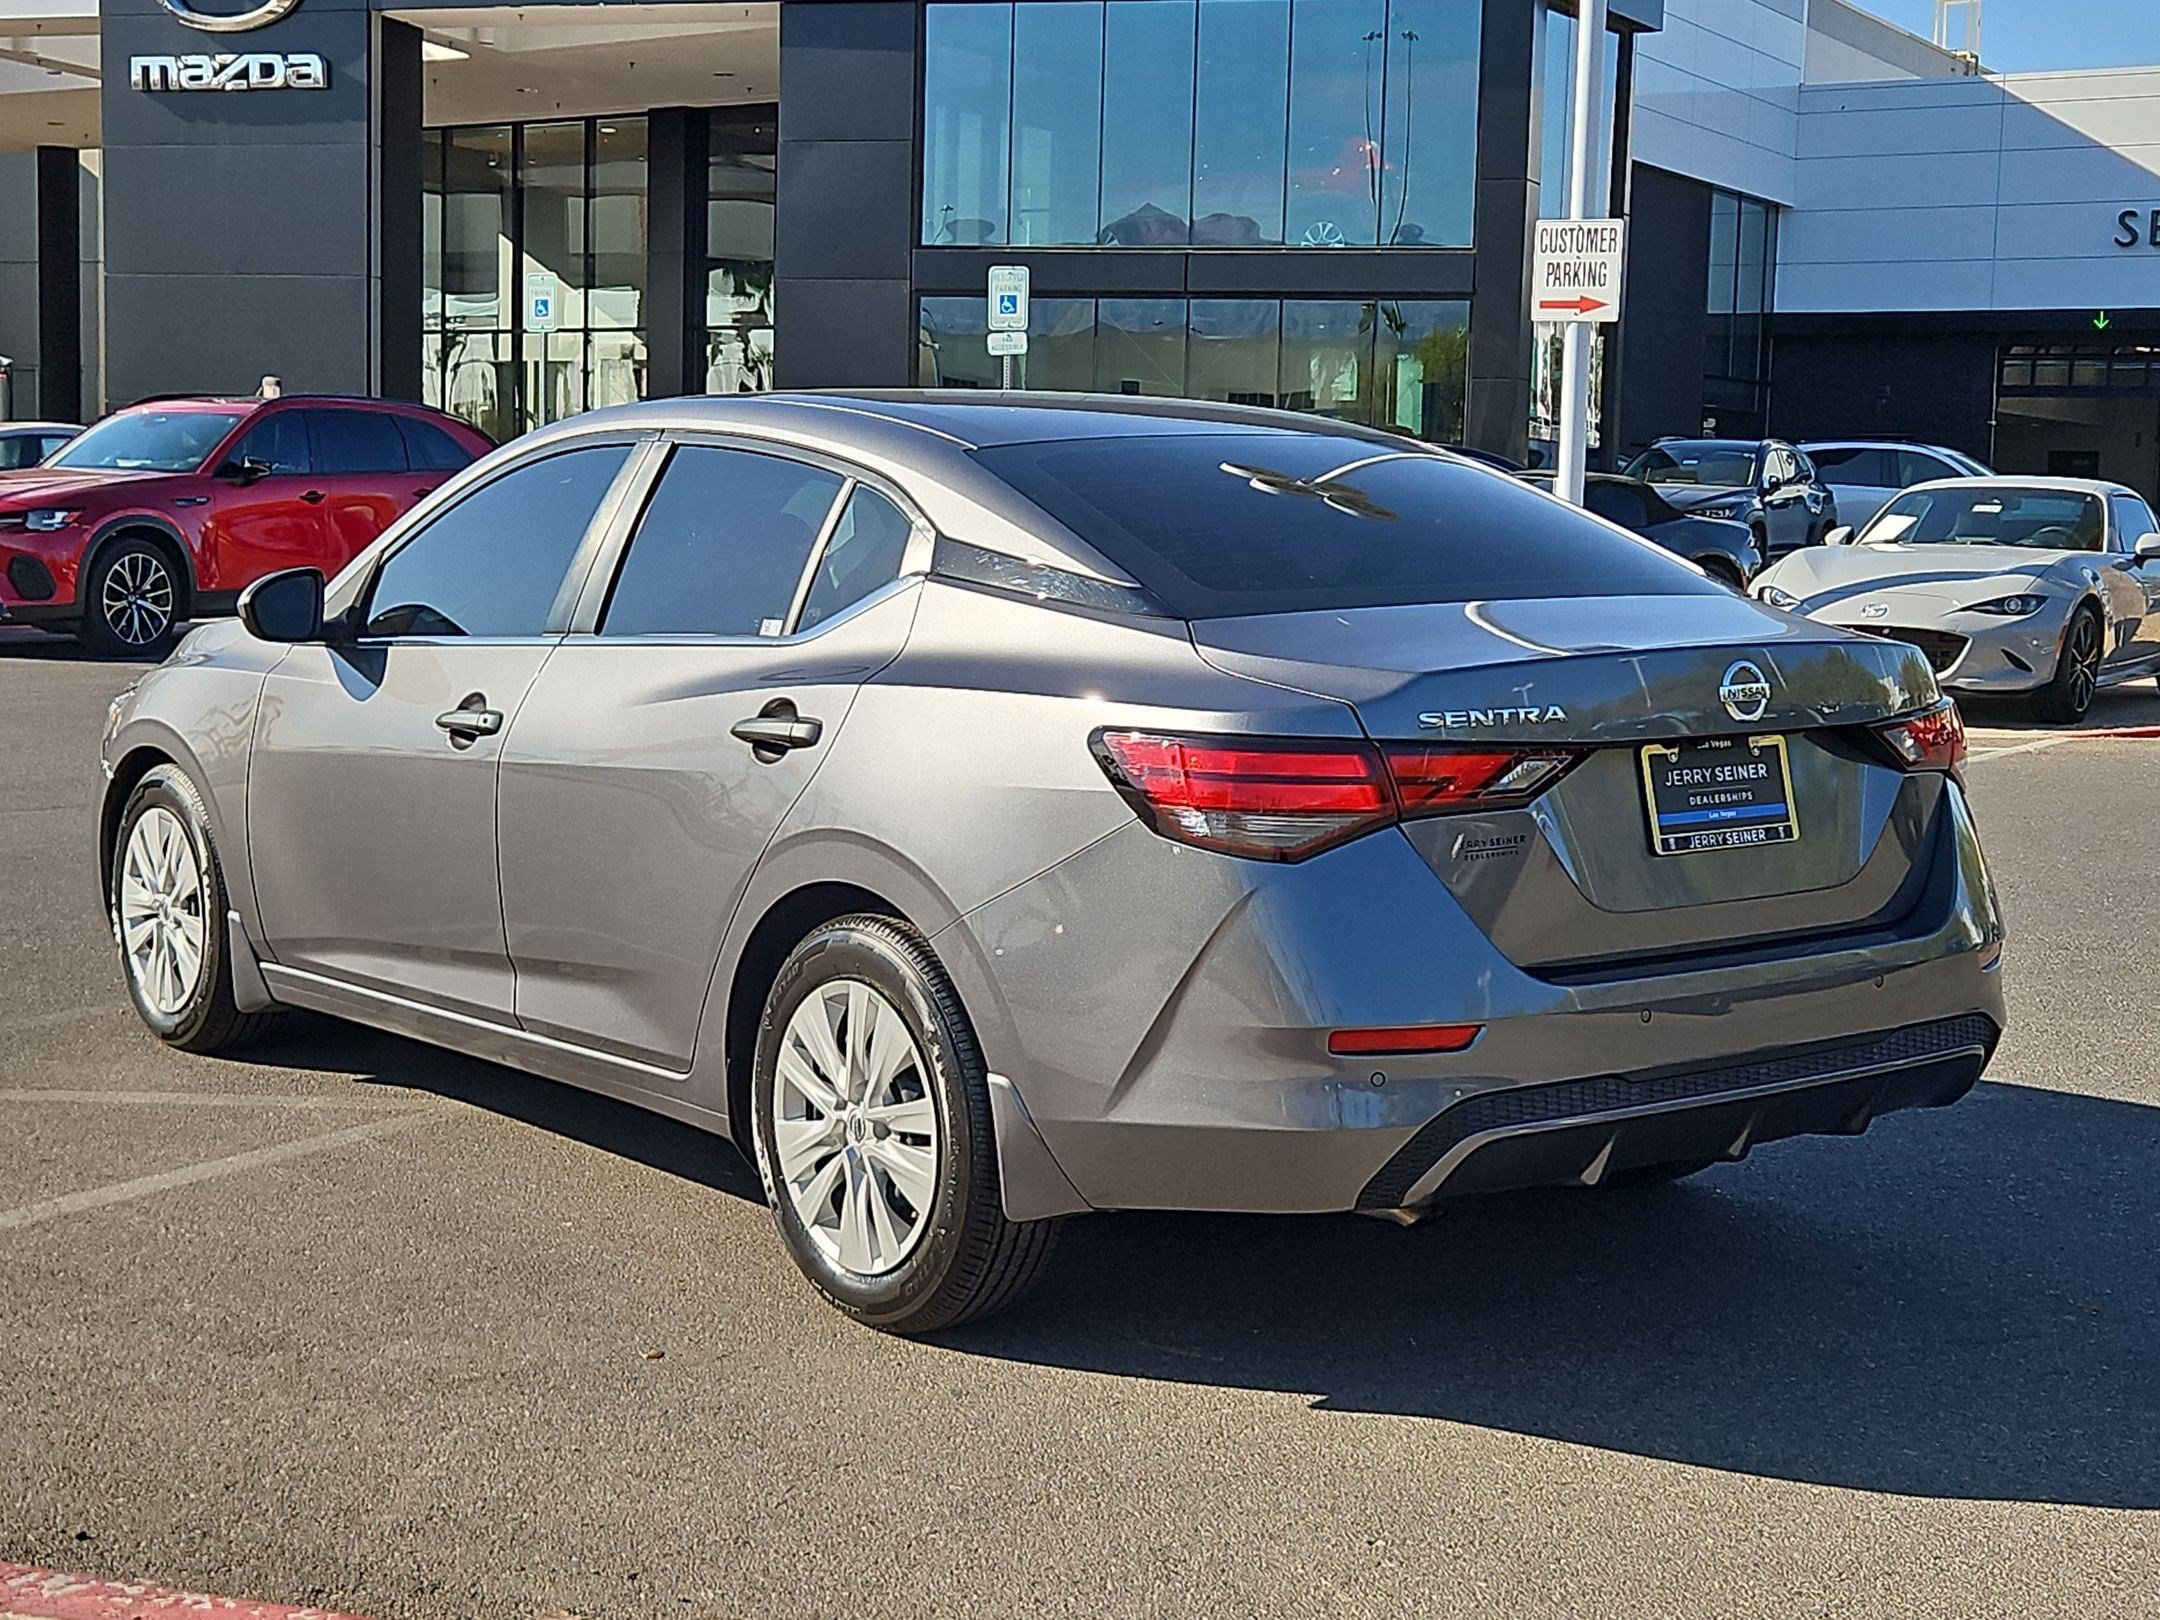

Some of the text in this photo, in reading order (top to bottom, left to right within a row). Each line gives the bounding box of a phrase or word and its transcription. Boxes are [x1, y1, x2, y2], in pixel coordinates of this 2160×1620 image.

[1539, 227, 1618, 254] CUSTOMER
[1545, 261, 1607, 288] PARKING
[1725, 685, 1767, 700] NISSAN
[1418, 705, 1568, 729] SENTRA
[1665, 763, 1769, 787] JERRY SEINER
[1689, 791, 1753, 806] DEALERSHIPS
[1457, 835, 1527, 850] ERRY SEINER
[1689, 829, 1767, 849] JERRY SEINER
